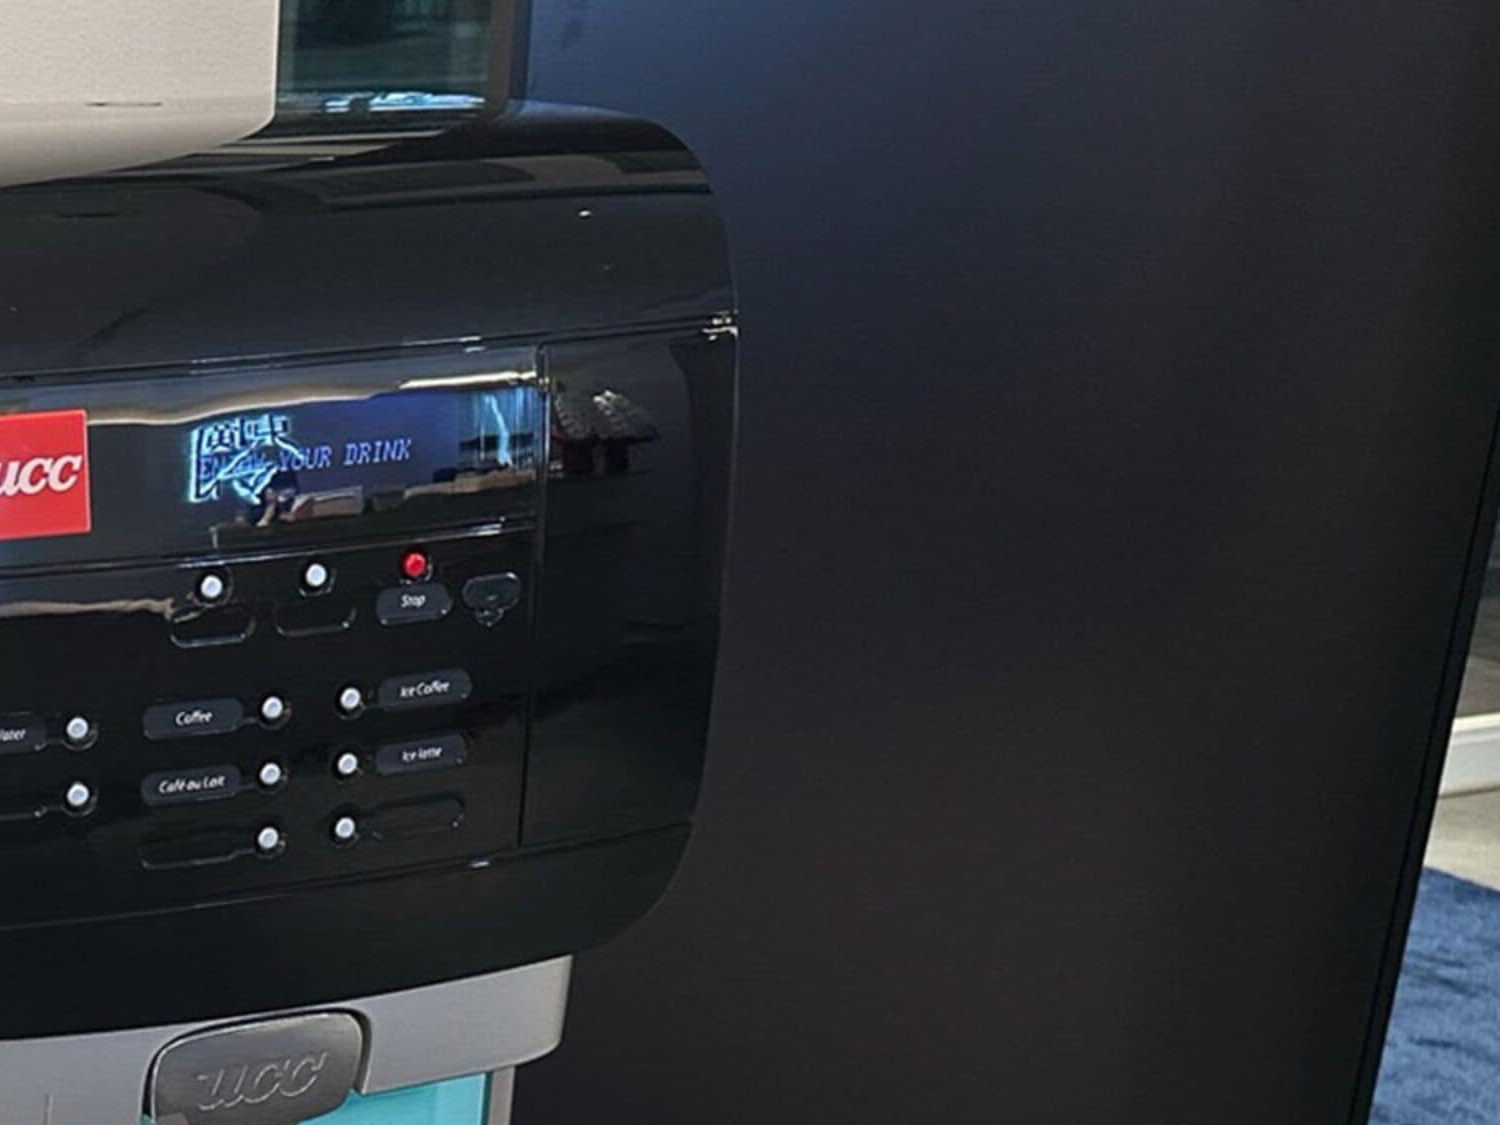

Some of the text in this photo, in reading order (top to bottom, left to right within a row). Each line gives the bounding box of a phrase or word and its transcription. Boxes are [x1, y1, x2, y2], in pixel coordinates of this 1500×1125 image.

[277, 445, 332, 472] YOUR
[344, 439, 412, 466] DRINK
[401, 594, 426, 608] Stop
[415, 680, 450, 696] Coffee
[176, 709, 212, 726] Coffee
